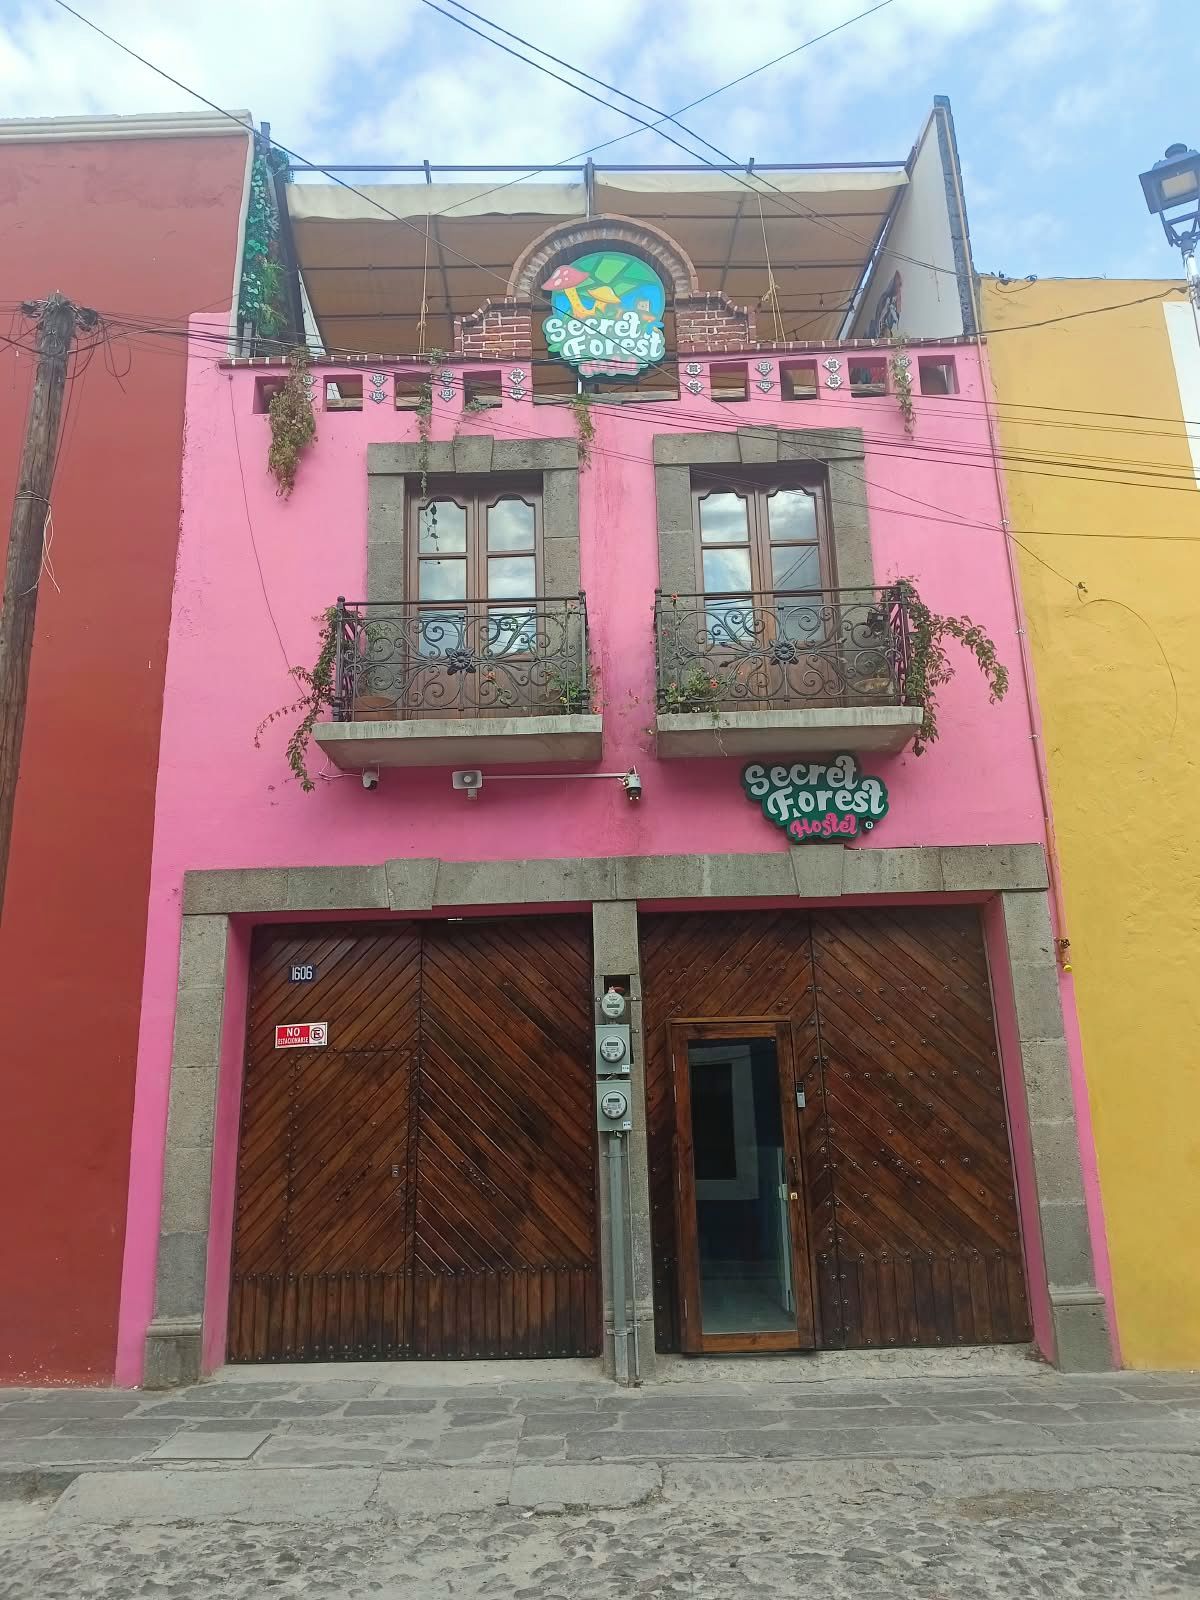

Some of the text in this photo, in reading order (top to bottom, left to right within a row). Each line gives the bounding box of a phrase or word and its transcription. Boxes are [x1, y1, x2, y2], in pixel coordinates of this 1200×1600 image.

[545, 311, 642, 342] Secret
[562, 330, 662, 358] Forest
[745, 755, 858, 795] Secret
[767, 779, 885, 821] Forest
[790, 812, 857, 838] Hostel
[291, 965, 313, 981] 1606
[278, 1036, 309, 1045] ESTACIONARSE
[286, 1027, 301, 1037] NO
